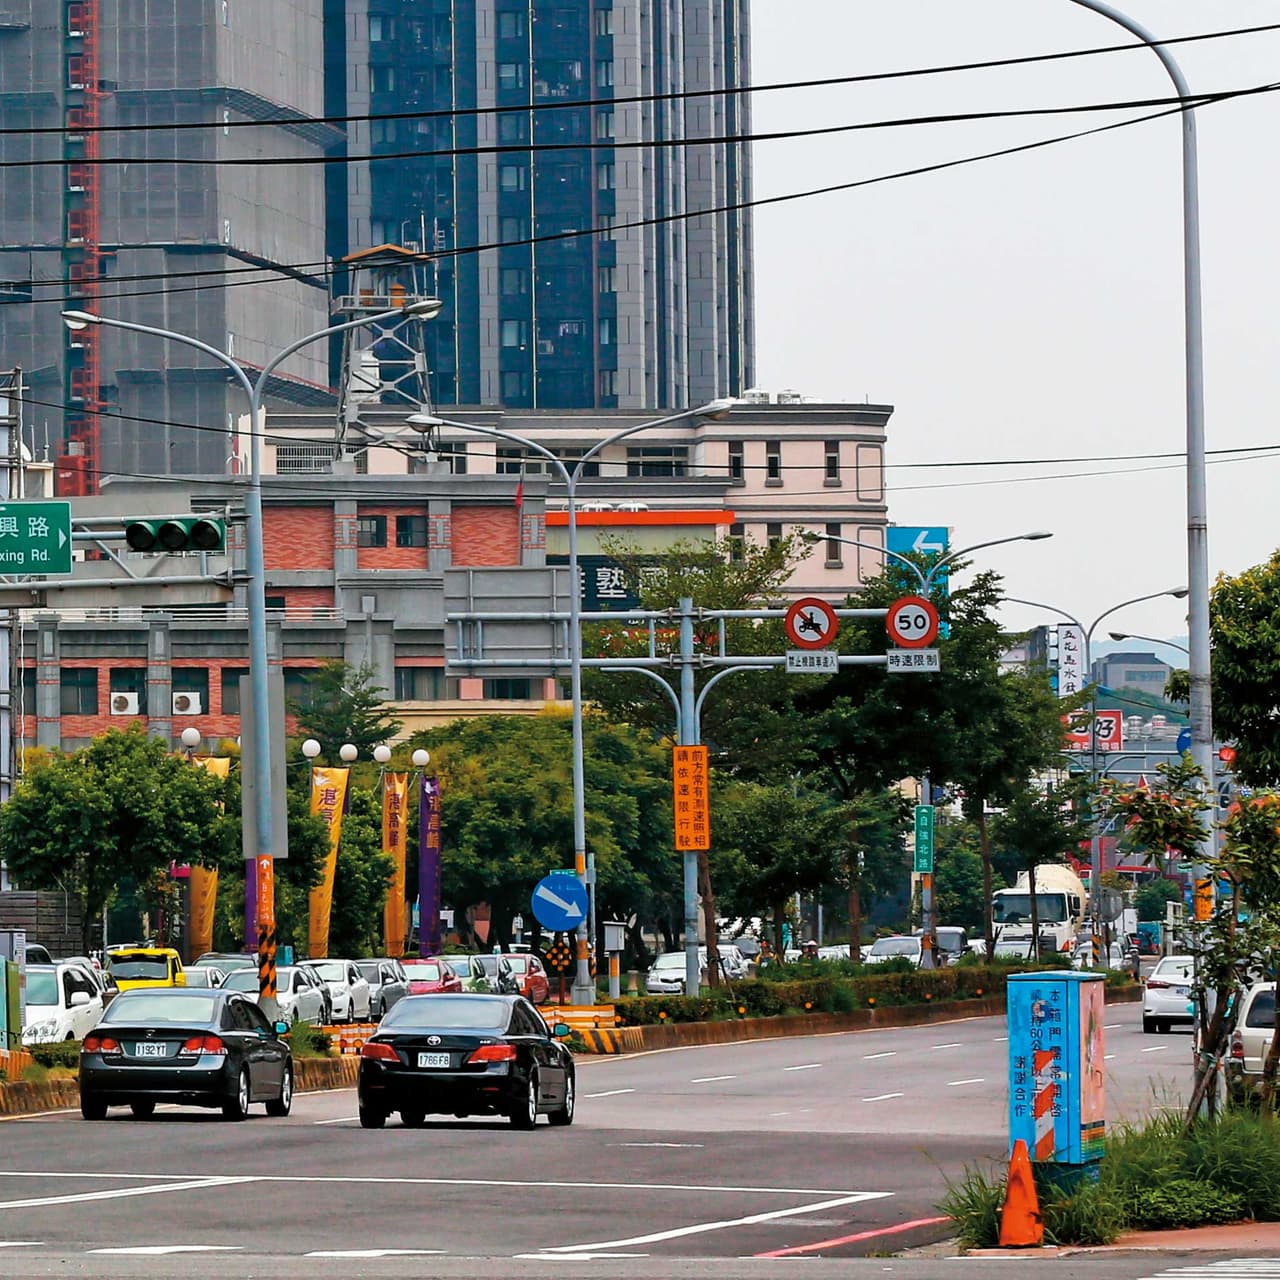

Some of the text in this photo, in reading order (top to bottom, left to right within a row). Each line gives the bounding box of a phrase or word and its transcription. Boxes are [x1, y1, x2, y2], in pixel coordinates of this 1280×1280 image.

[31, 549, 50, 561] Rd.
[899, 615, 926, 630] 50
[890, 655, 938, 667] 時速限制
